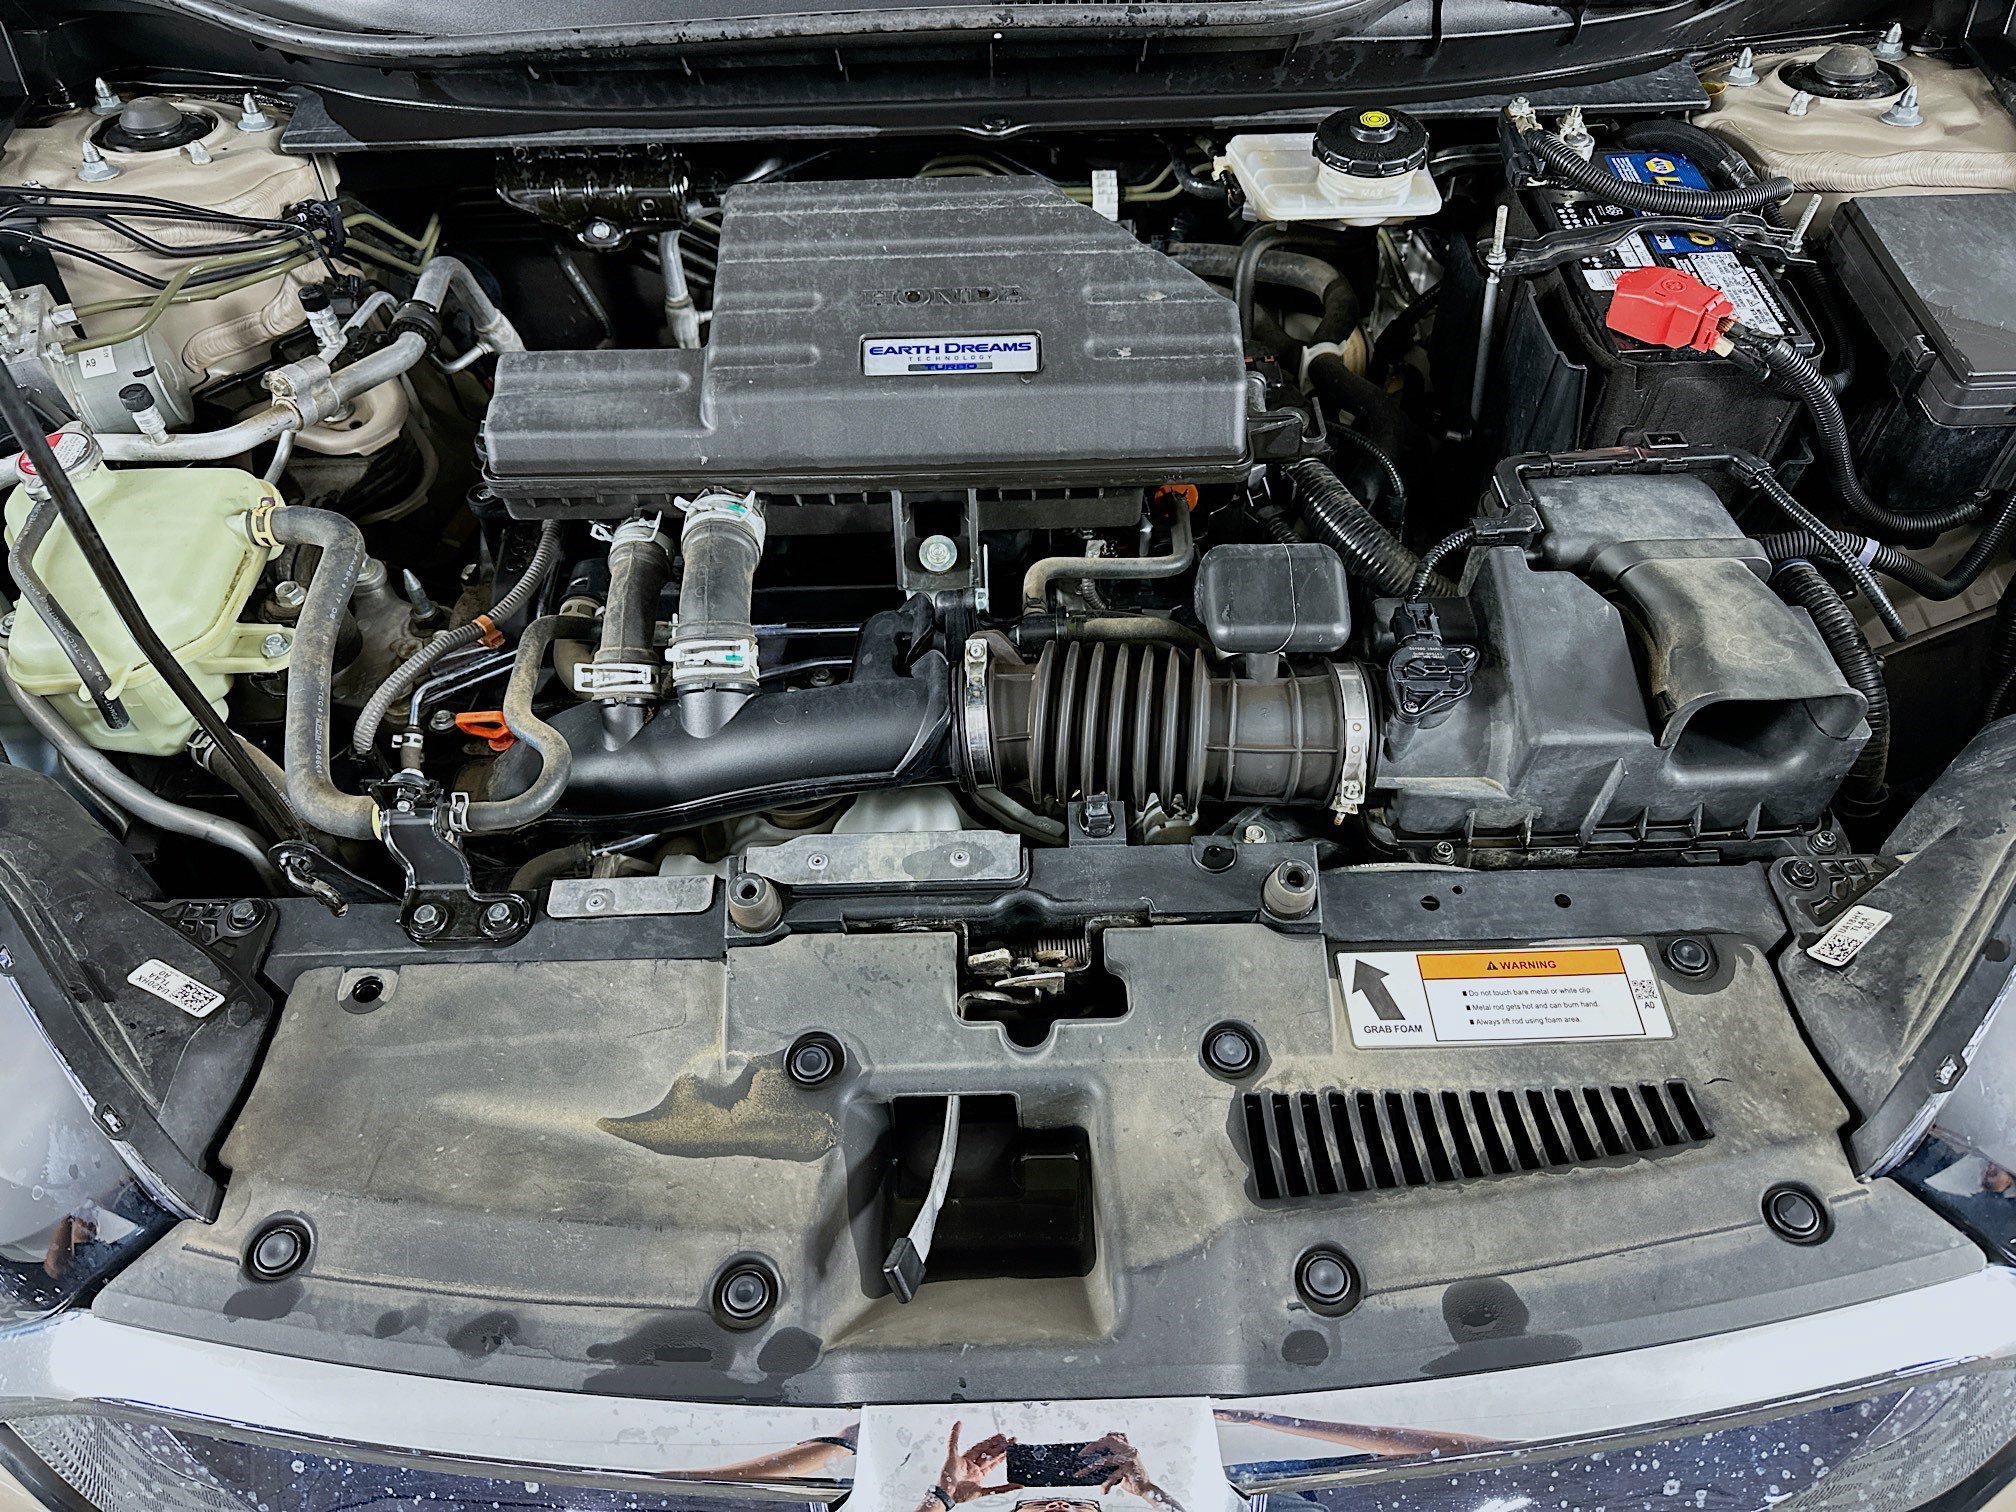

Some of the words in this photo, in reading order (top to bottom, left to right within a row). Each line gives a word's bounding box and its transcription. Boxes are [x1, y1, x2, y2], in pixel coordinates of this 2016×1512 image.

[861, 285, 1034, 306] HONDA
[869, 344, 940, 356] EARTH
[944, 342, 1032, 354] DREAMS
[86, 358, 96, 368] A9
[925, 362, 978, 370] TURBO
[1500, 960, 1556, 970] WARNING
[1364, 1024, 1392, 1034] GRAB
[1394, 1024, 1423, 1034] FOAM
